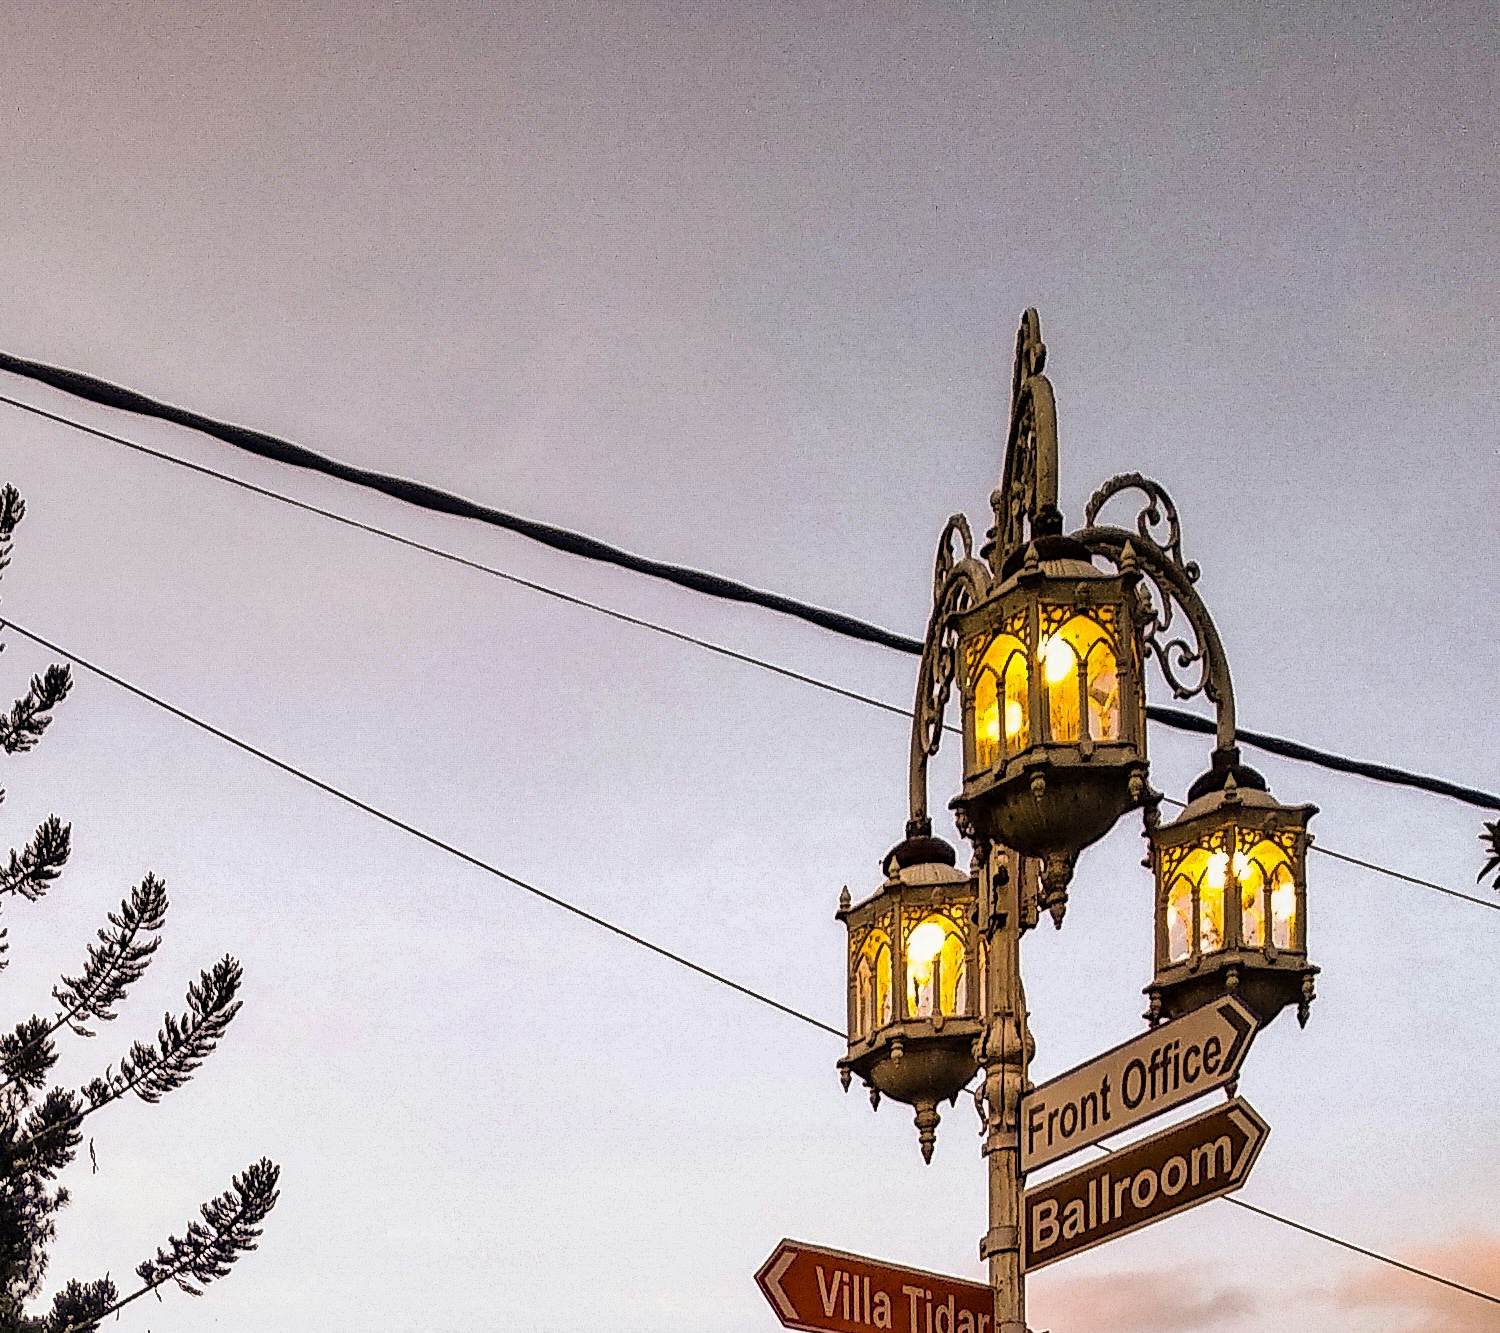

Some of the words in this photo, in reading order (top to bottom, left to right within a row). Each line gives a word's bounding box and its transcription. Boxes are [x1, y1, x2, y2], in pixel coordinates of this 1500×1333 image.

[1028, 1075, 1111, 1155] Front
[1121, 1035, 1222, 1111] Office
[1032, 1131, 1233, 1251] Ballroom
[815, 1265, 892, 1330] Villa
